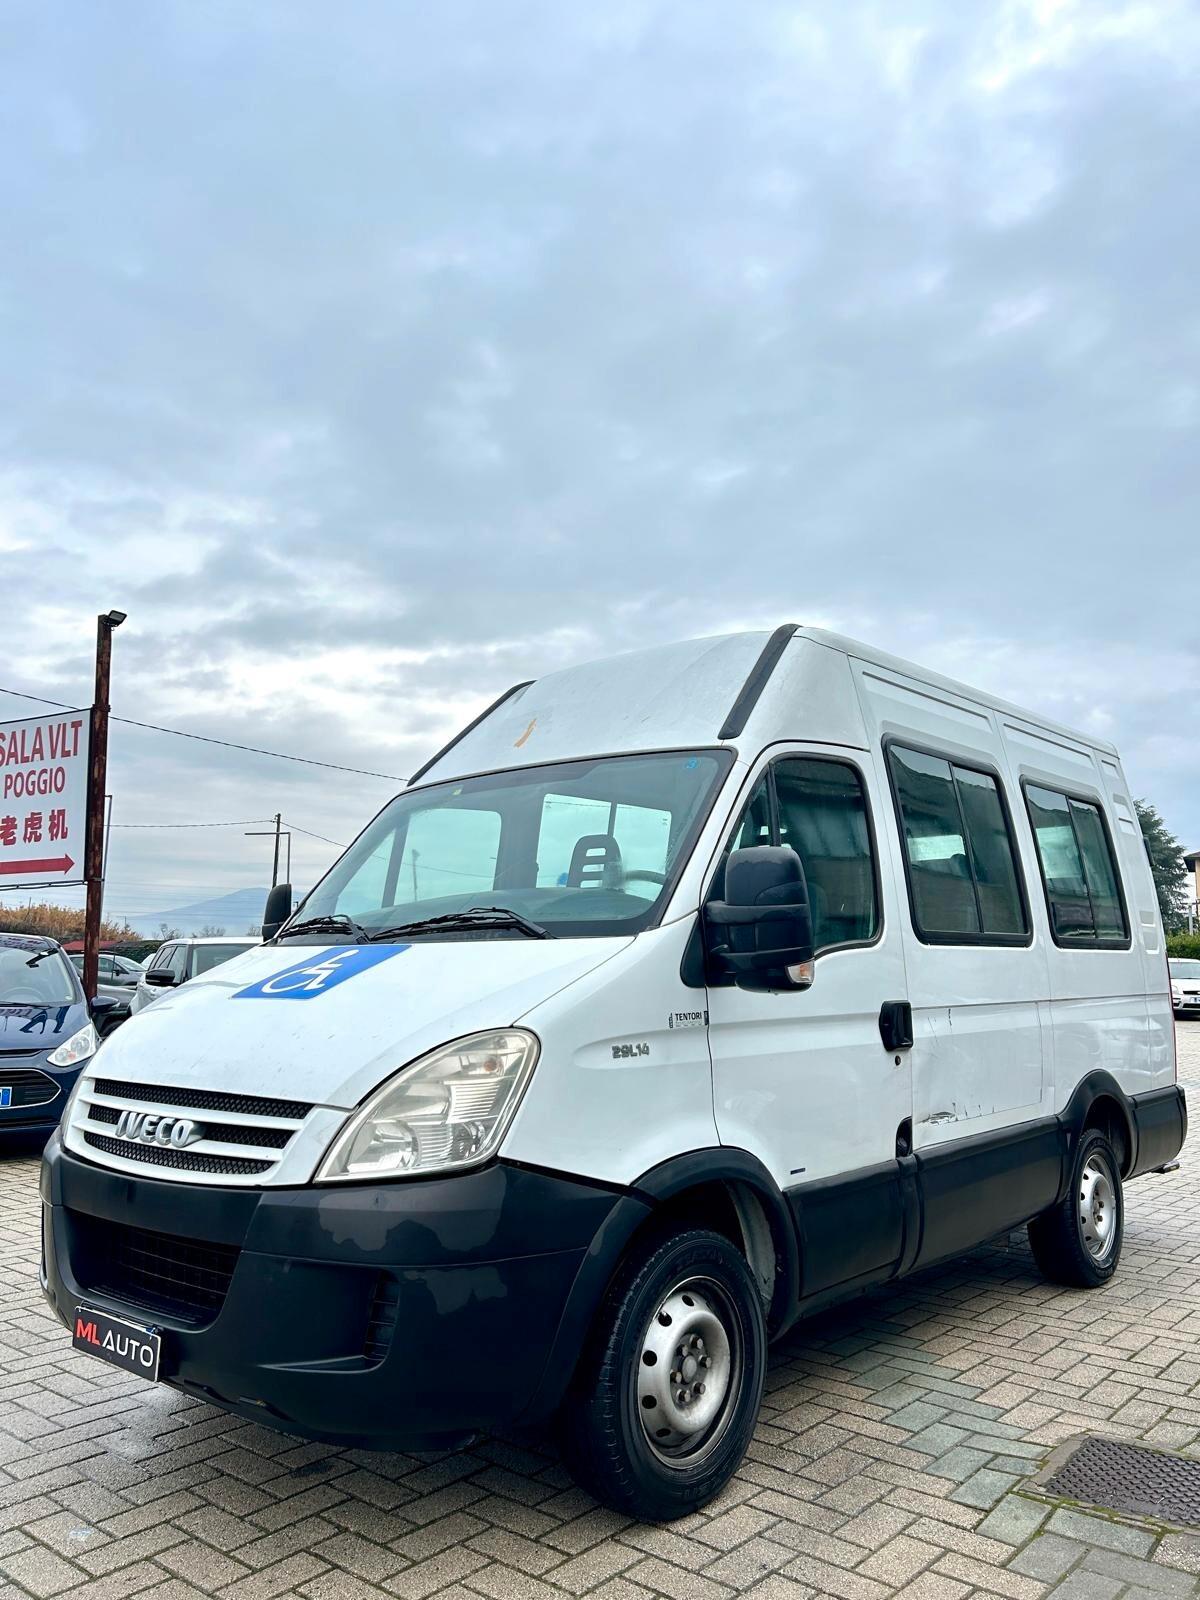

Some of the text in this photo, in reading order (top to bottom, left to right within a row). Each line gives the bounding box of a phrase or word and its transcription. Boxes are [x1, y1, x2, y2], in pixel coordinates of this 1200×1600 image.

[48, 720, 83, 759] VLT
[4, 766, 66, 799] POGGIO
[0, 809, 68, 846] 老虎机
[675, 1012, 703, 1021] TENTORI
[115, 1110, 195, 1149] IVECO
